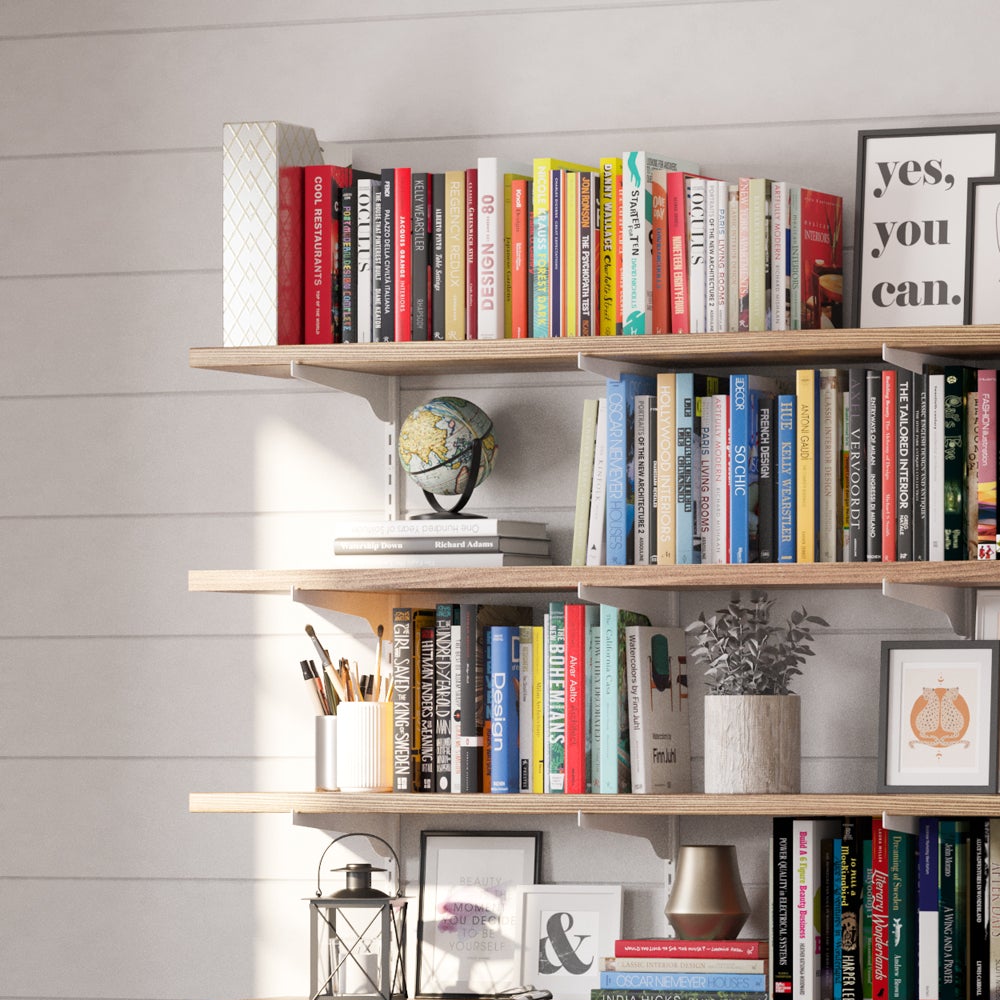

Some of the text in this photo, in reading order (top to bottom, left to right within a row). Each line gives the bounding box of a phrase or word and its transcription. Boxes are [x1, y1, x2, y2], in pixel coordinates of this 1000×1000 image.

[449, 181, 461, 241] REGENCY
[603, 164, 613, 251] DANNY WALLACE
[873, 158, 955, 198] yes,
[314, 176, 322, 286] COOL RESTAURANTS
[358, 194, 370, 273] OCULUS
[414, 180, 425, 251] KELLY WEARSTLER
[537, 166, 547, 325] NICOLE KRAUSS FOREST DARK
[630, 190, 640, 256] STARTER TEN
[691, 192, 704, 265] OCULUS
[708, 218, 715, 227] OF
[871, 220, 950, 258] you
[449, 245, 461, 287] REDUX
[481, 194, 494, 311] DESIGN 80
[581, 235, 590, 316] THE PSYCHOPATH TEST
[672, 235, 684, 271] NINETEEN
[871, 278, 962, 307] can.
[638, 437, 645, 446] OF
[760, 408, 769, 478] FRENCH DESIGN
[800, 404, 810, 434] ANTONI
[824, 391, 832, 497] CLASSIC INTERIOR DESIGN
[899, 381, 909, 509] THE TAILORED INTERIOR
[608, 393, 623, 550] OSCAR NIEMEYER HOUSES
[660, 385, 671, 542] HOLLYWOOD INTERIORS
[701, 427, 710, 533] PARIS LIVING ROOMS
[734, 445, 746, 496] SO CHIC
[781, 402, 792, 542] HUE KELLY WEARSTLER
[851, 428, 860, 530] VERVOORDT
[381, 540, 403, 549] Down
[435, 540, 466, 549] Richard
[467, 540, 494, 548] Adams
[421, 640, 434, 717] HITMAN ANDERS
[549, 644, 564, 744] BOHEMIANS
[570, 655, 578, 703] Alvar Aalto
[629, 634, 638, 684] Watercolors
[393, 658, 409, 775] SAVED KING SWEDEN
[491, 672, 506, 752] Design
[460, 877, 502, 886] BEAUTY
[891, 836, 902, 874] Dreaming
[482, 929, 495, 938] BE
[779, 837, 787, 966] POWER QUALITY ELECTRICAL SYSTEMS
[797, 885, 807, 939] Beauty Business
[872, 868, 888, 980] Literary Wonderlands
[449, 941, 505, 951] YOURSELF
[538, 912, 595, 976] &
[842, 955, 855, 986] HARPER
[944, 913, 953, 984] WING PRAYER
[616, 975, 750, 989] OSCAR NIEMEYER HOUSES
